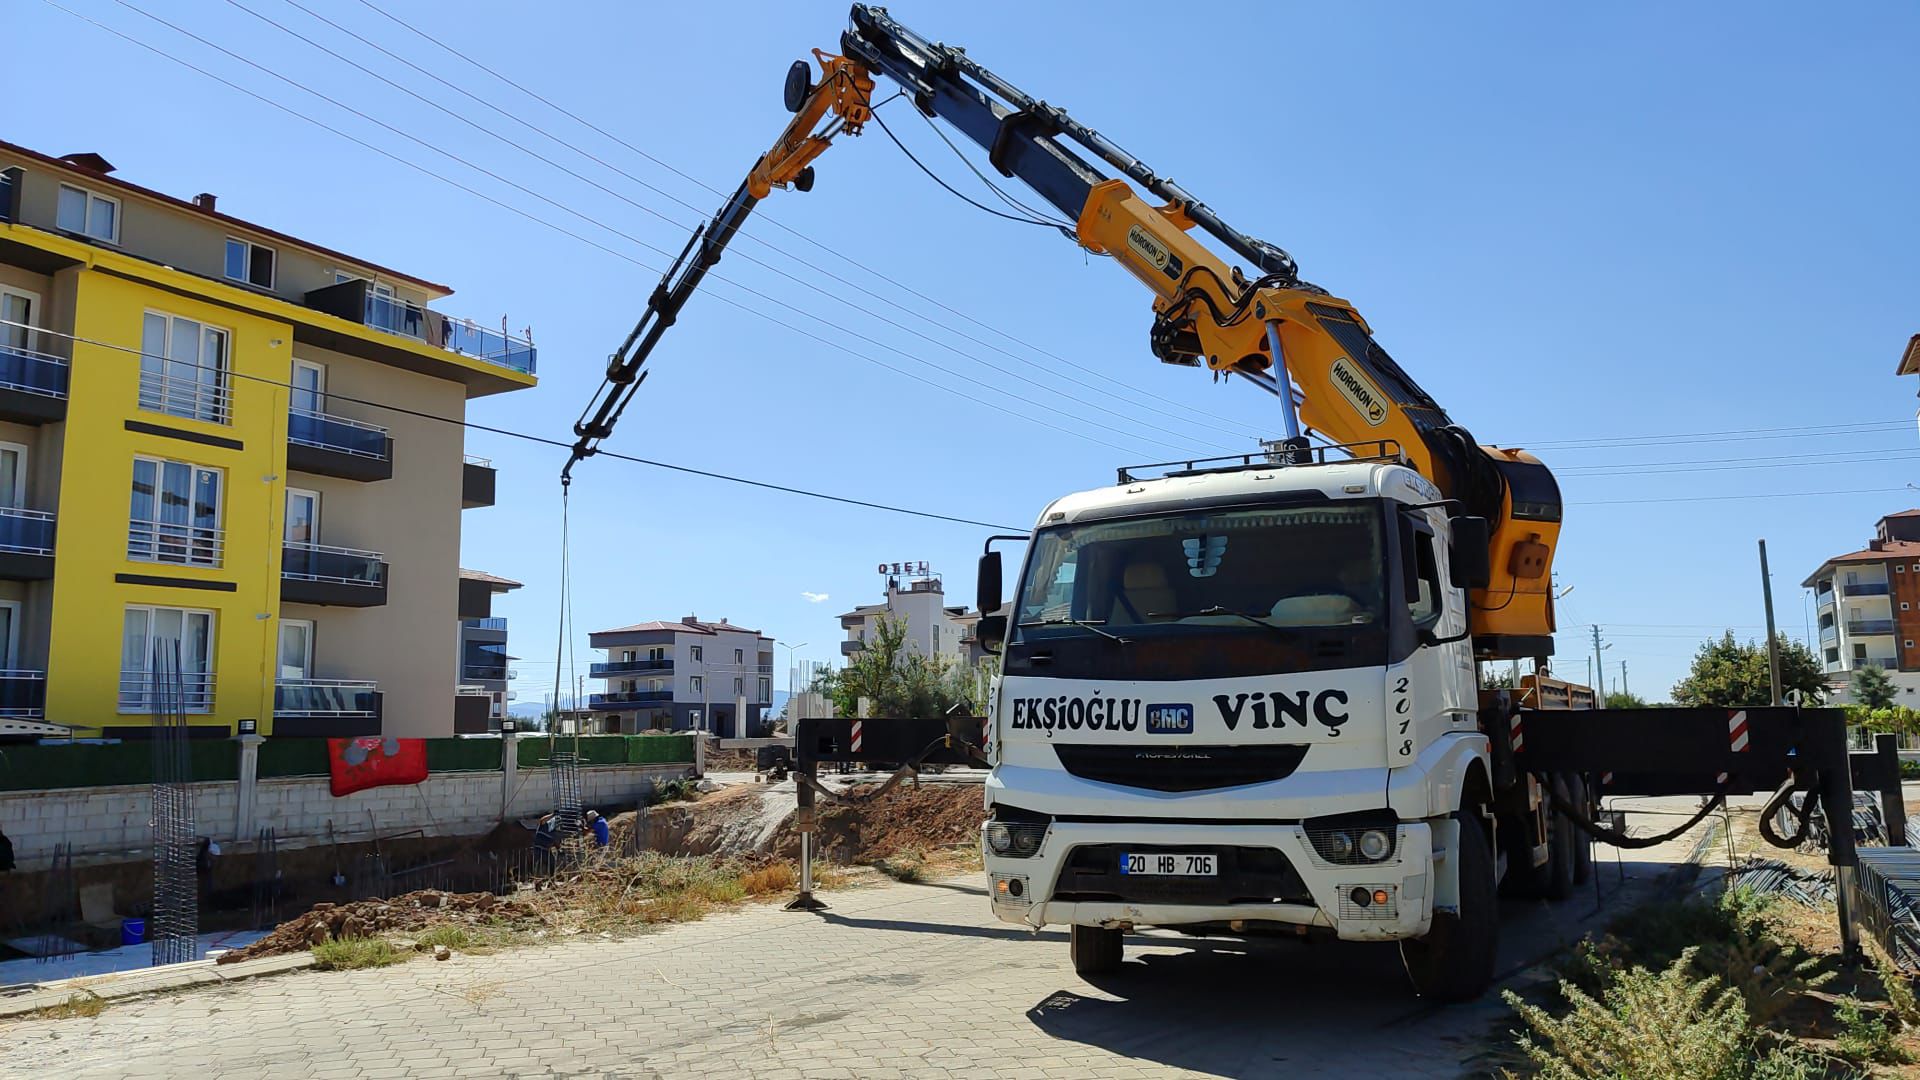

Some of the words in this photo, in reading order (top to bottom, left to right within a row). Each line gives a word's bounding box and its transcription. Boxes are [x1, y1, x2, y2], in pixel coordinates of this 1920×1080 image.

[878, 560, 927, 575] OTEL
[1150, 708, 1189, 729] BMC
[1393, 677, 1413, 756] 2018
[1129, 856, 1146, 873] 20
[1158, 856, 1175, 873] HB
[1186, 857, 1212, 874] 706
